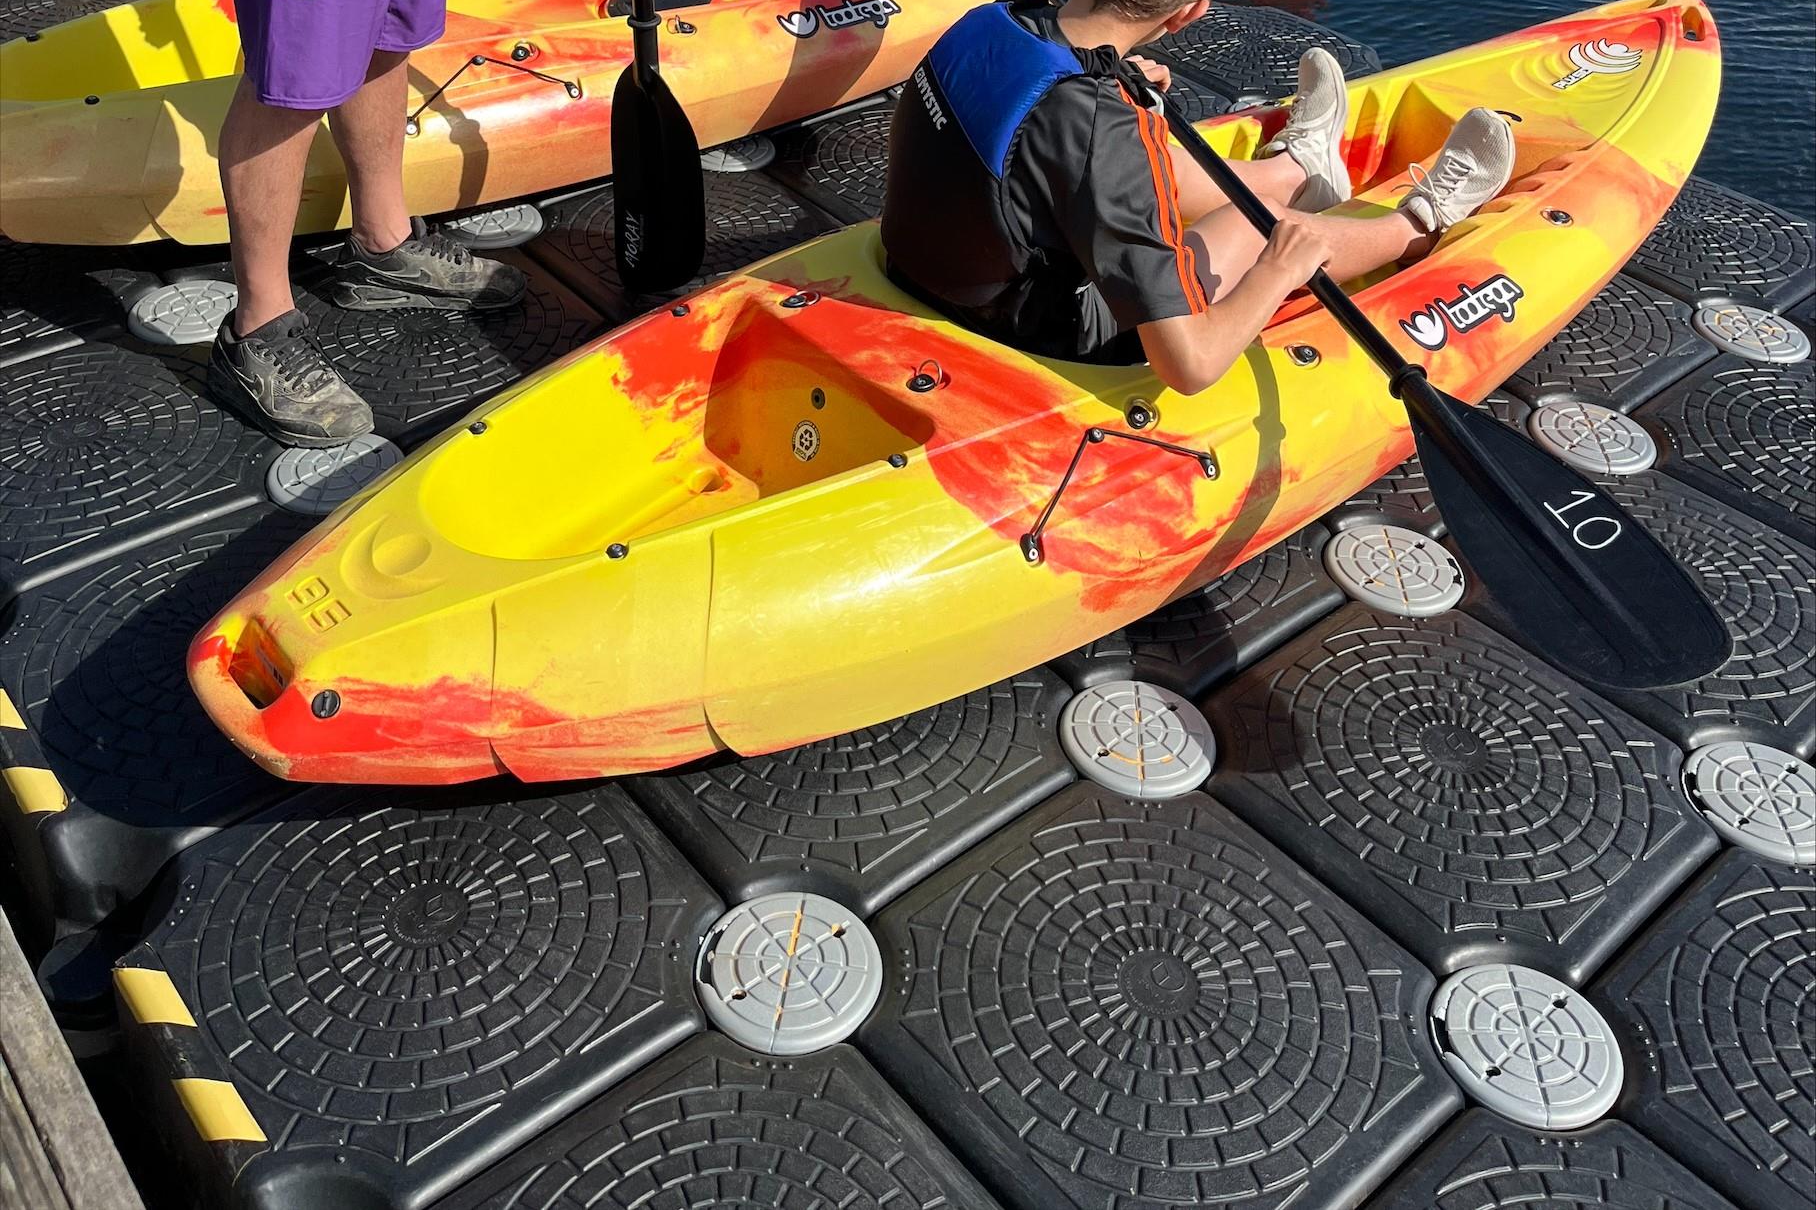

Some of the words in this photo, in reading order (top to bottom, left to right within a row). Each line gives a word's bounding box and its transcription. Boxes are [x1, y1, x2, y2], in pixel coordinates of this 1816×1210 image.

[917, 77, 948, 131] MYSTIC
[1434, 275, 1524, 323] tootega
[1543, 490, 1622, 550] 10
